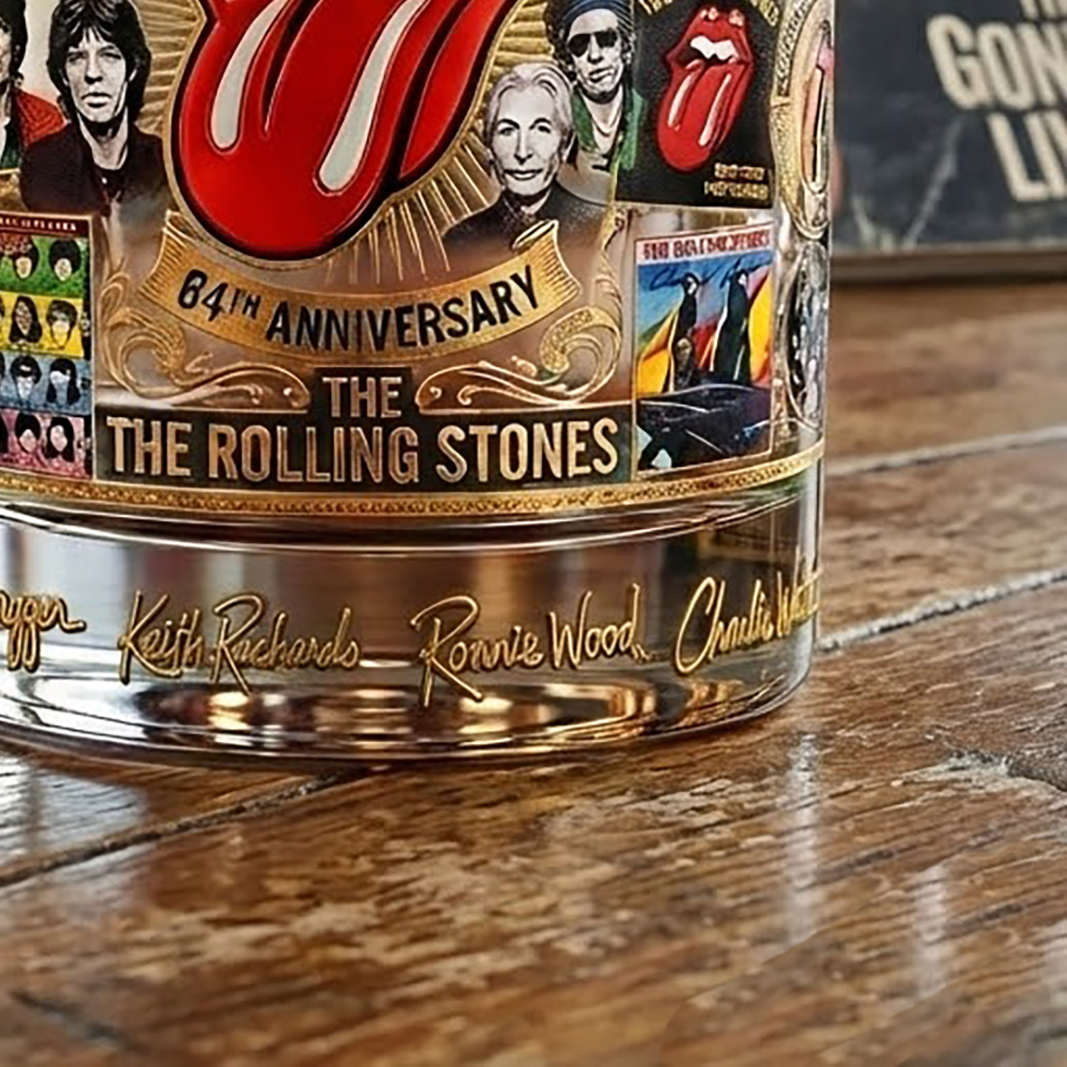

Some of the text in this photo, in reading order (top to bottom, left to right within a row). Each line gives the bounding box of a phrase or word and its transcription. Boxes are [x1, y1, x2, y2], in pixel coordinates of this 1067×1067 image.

[265, 264, 539, 353] ANNIVERSARY
[322, 376, 402, 418] THE
[106, 416, 619, 483] THE ROLLING STONES
[118, 589, 204, 684] Keith
[410, 595, 545, 708] Ronnie
